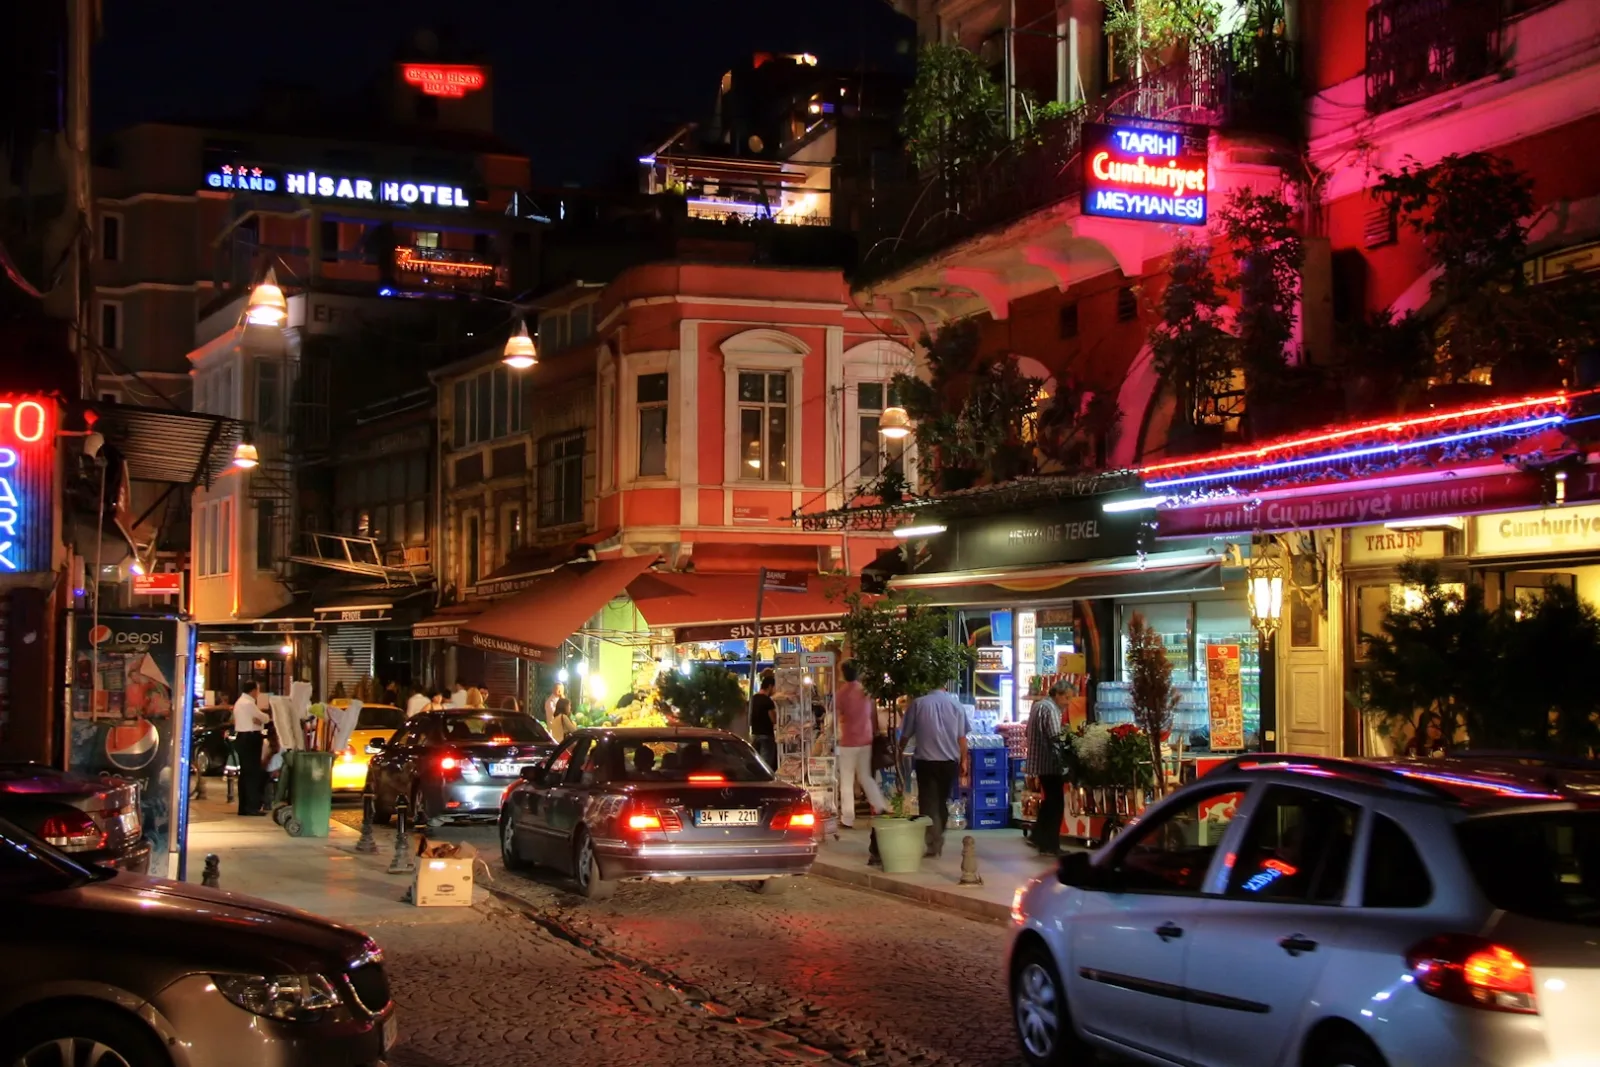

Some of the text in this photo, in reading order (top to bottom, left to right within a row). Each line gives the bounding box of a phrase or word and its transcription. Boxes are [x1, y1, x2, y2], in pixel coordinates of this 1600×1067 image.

[1092, 151, 1206, 197] Cumhuriyet
[208, 173, 276, 191] GRAND
[384, 182, 469, 207] HOTEL
[1267, 490, 1393, 524] Cumhuriyet
[1065, 520, 1100, 540] TEKEL
[341, 611, 361, 620] PEYOTE
[115, 629, 164, 645] pepsi
[701, 810, 757, 822] 34 VF 2211
